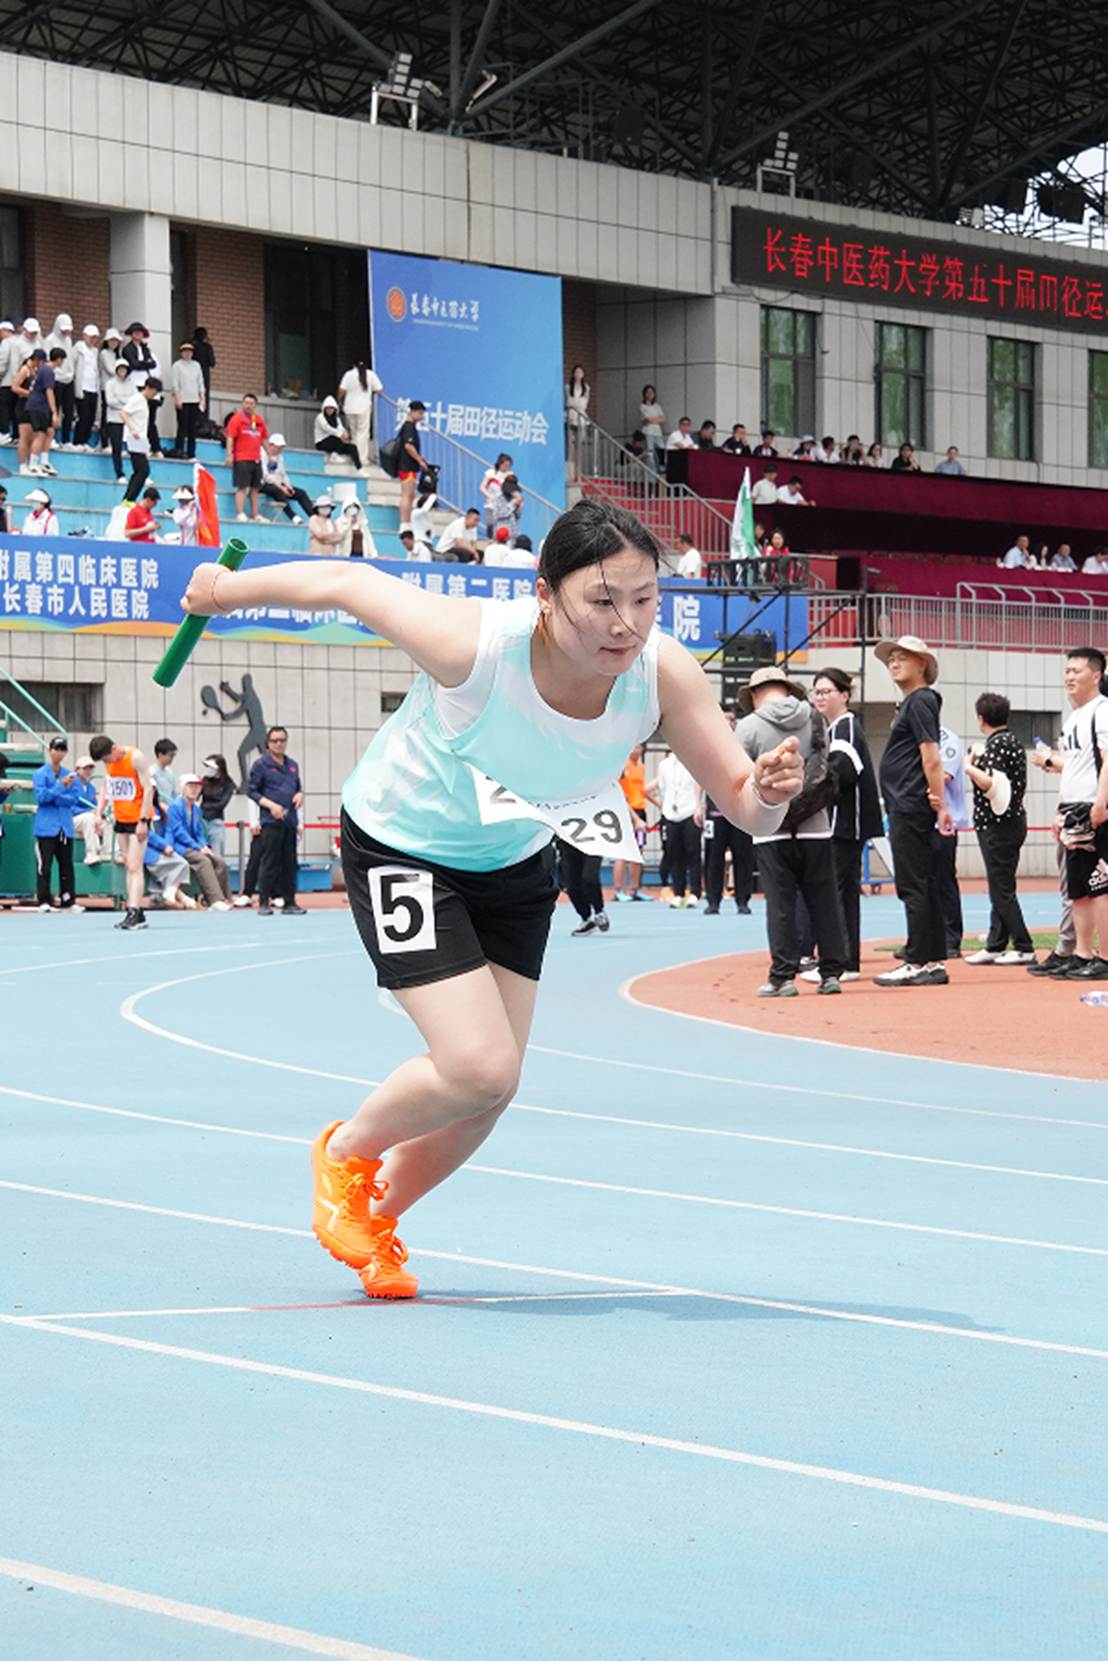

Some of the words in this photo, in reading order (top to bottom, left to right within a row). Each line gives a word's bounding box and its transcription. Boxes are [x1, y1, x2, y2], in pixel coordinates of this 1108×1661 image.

[763, 226, 1108, 320] 长春中医药大学第五十届田径运
[3, 582, 150, 619] 长春市人民医院
[662, 594, 700, 641] 院
[560, 809, 624, 844] 29
[379, 873, 424, 942] 5
